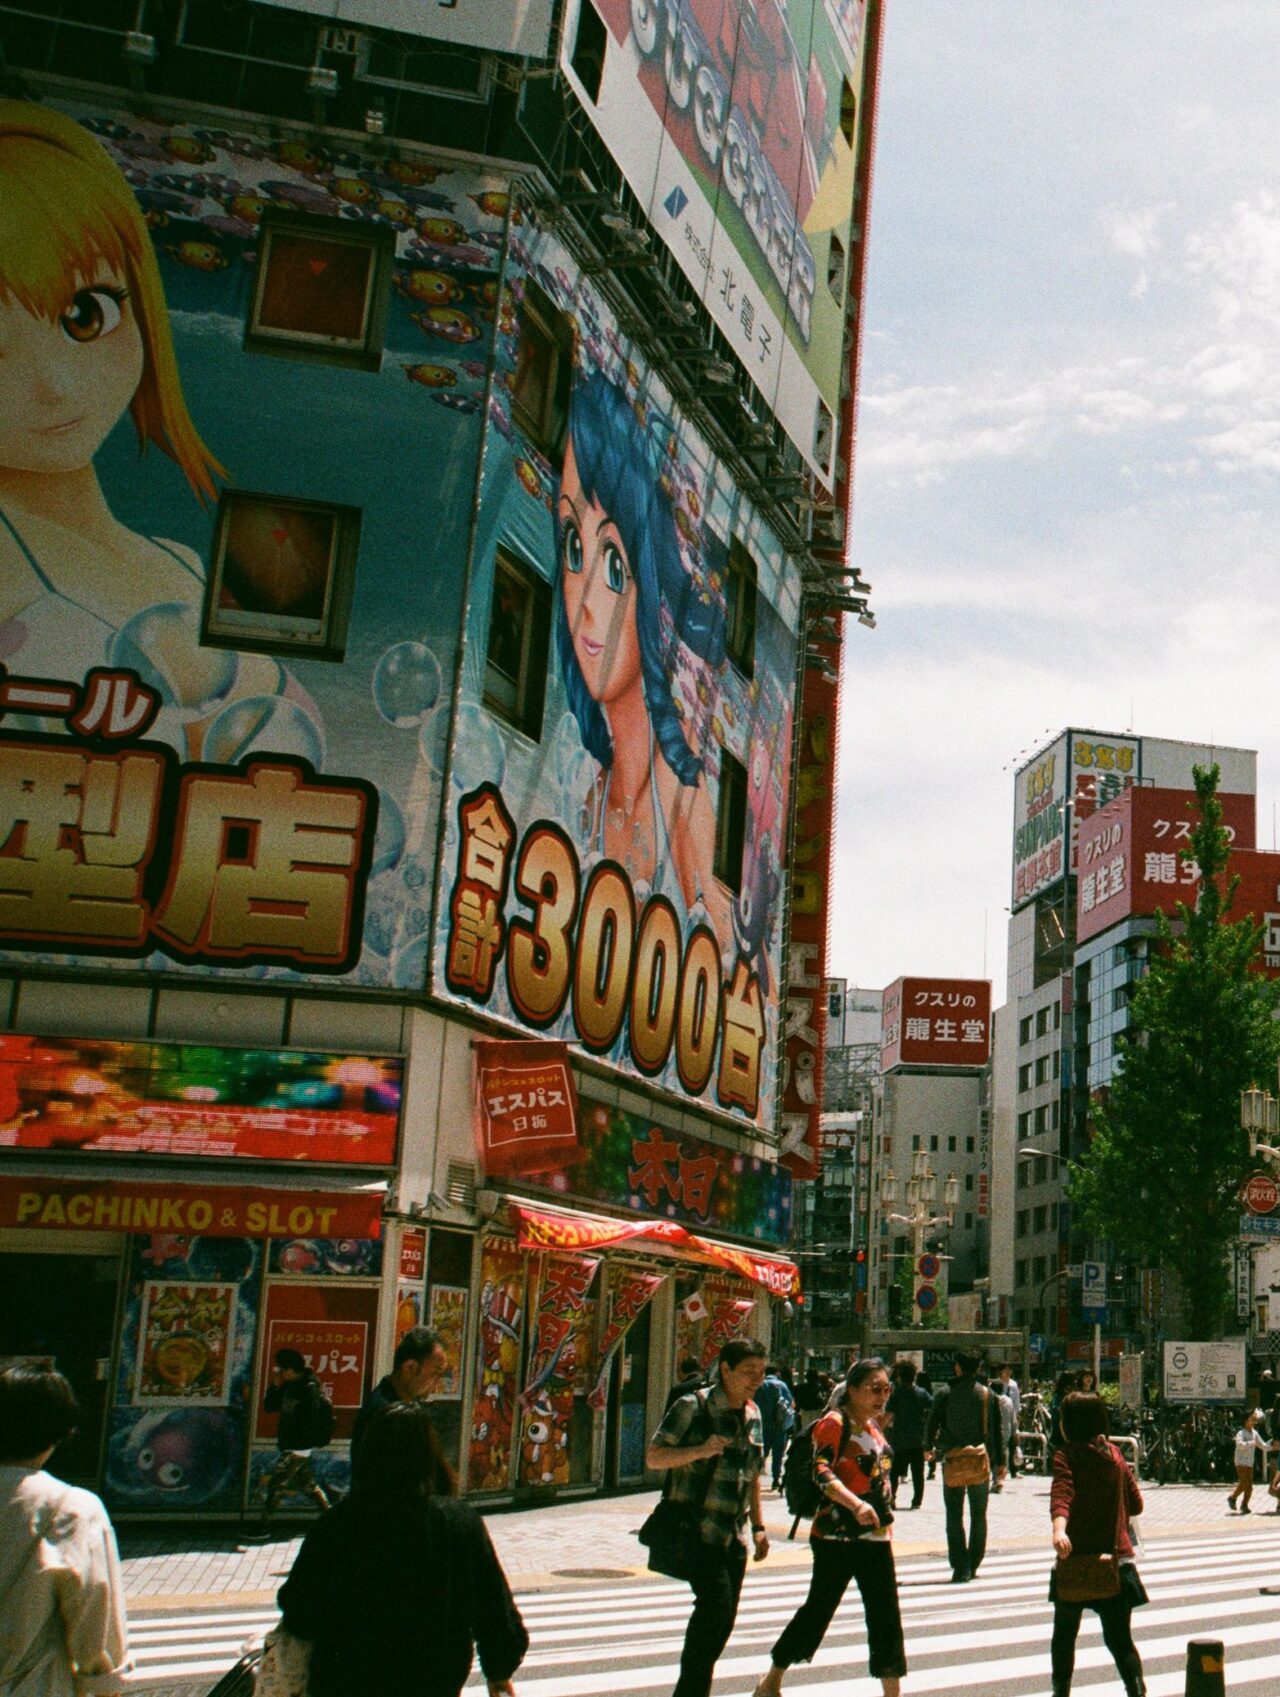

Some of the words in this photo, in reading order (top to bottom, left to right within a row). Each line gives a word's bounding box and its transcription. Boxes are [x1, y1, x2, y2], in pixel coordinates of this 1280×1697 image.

[1085, 823, 1124, 865] クスリの
[914, 990, 977, 1009] クスリの
[905, 1017, 986, 1044] 龍生堂
[488, 1087, 567, 1118] エスパス
[16, 1193, 213, 1231] PACHINKO
[219, 1205, 238, 1229] &
[246, 1202, 338, 1234] SLOT
[1085, 1264, 1100, 1288] P
